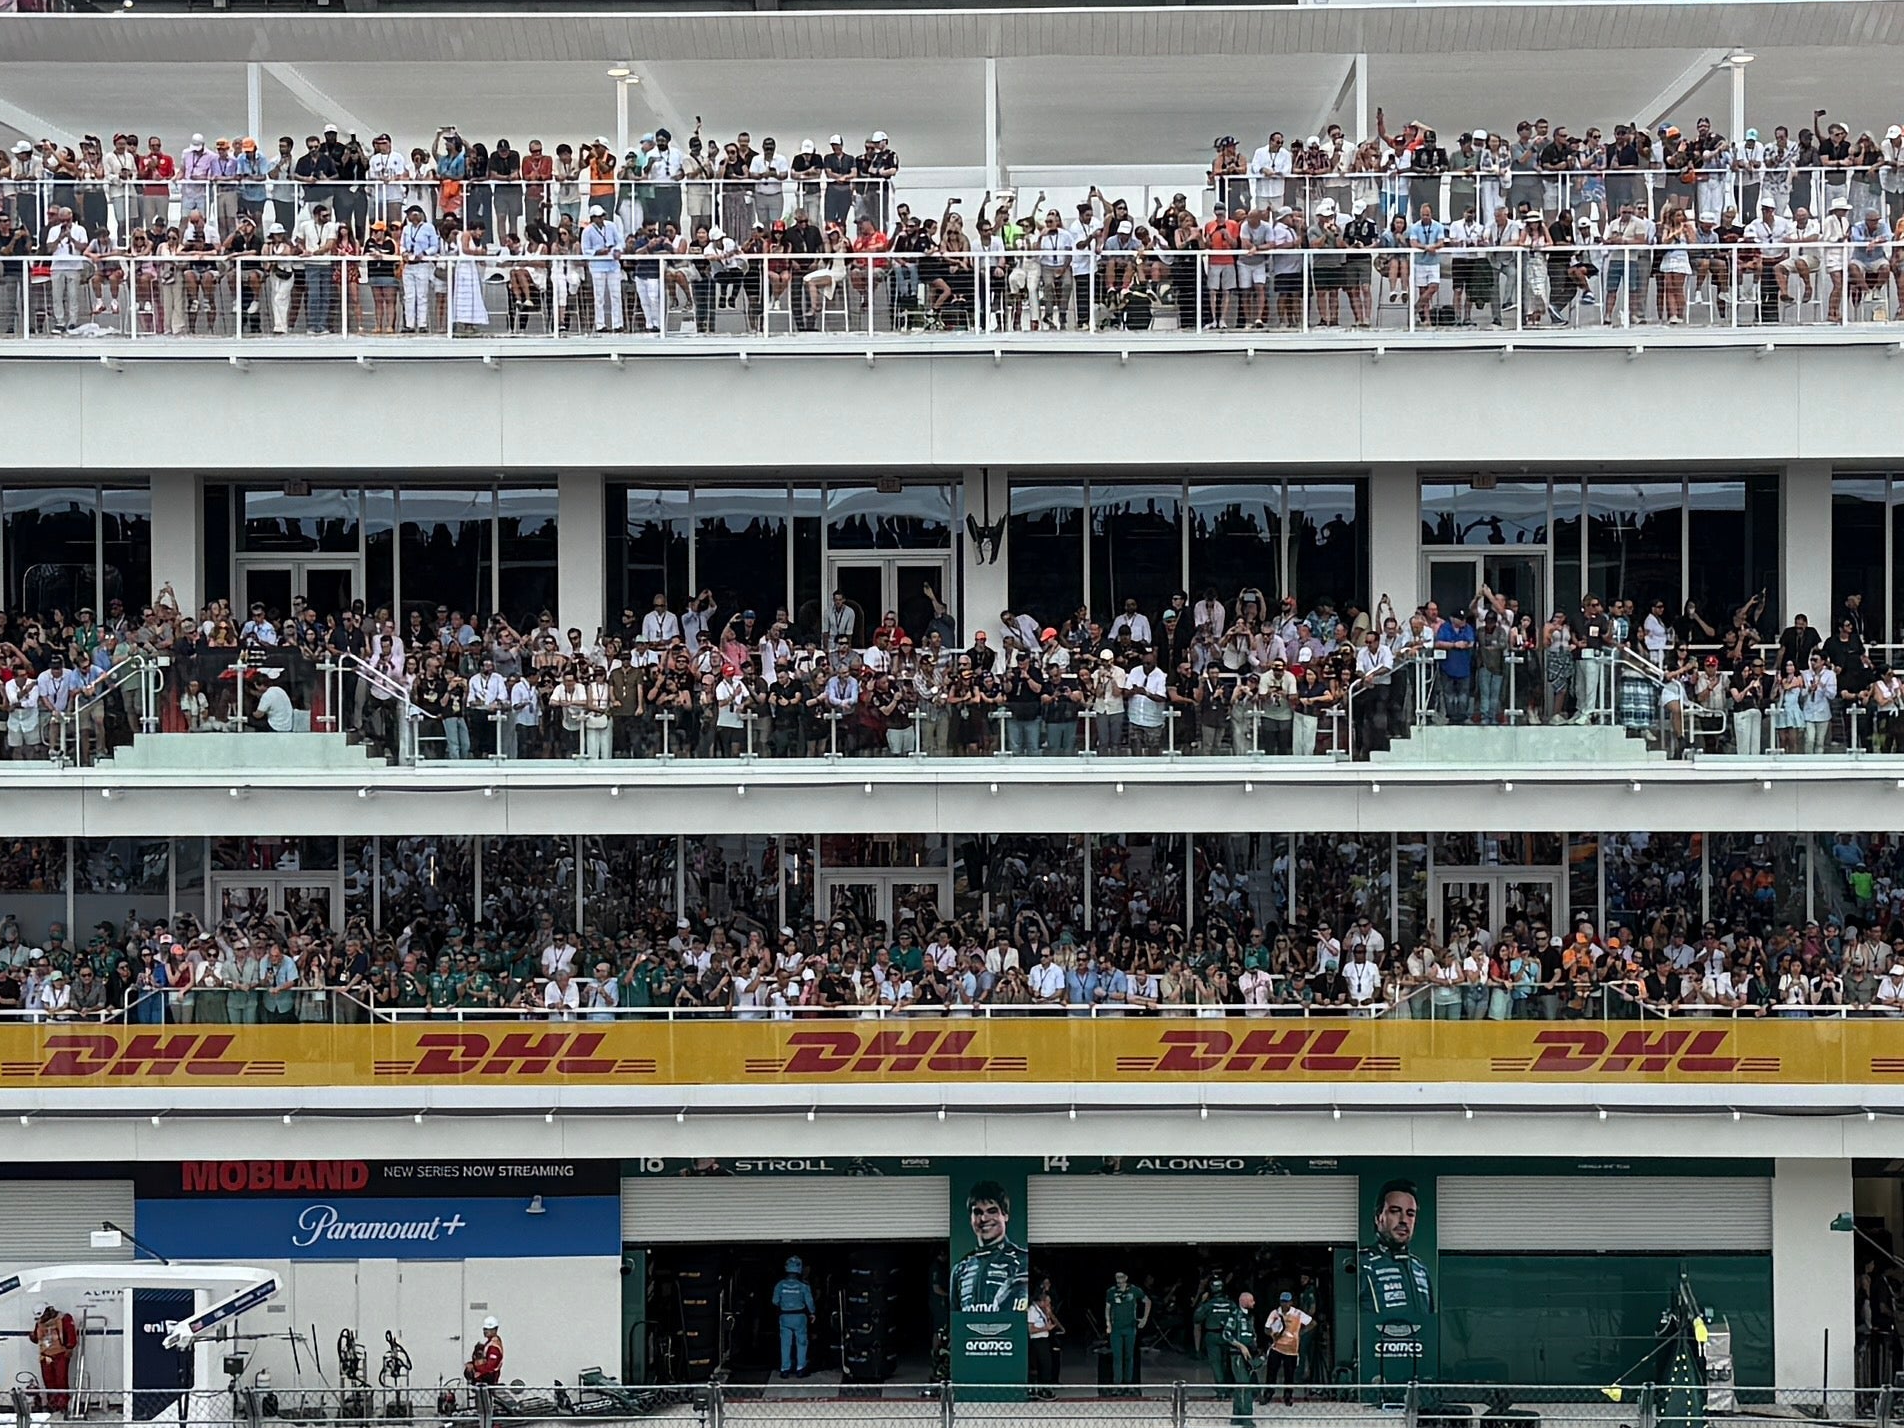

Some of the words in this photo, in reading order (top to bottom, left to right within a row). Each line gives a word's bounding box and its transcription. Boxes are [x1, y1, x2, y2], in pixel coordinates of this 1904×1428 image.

[42, 1035, 242, 1076] DHL
[415, 1033, 615, 1074] DHL
[786, 1031, 986, 1072] DHL
[1158, 1030, 1359, 1071] DHL
[1534, 1031, 1736, 1071] DHL
[181, 1161, 369, 1193] MOBLAND
[384, 1165, 414, 1178] NEW
[417, 1166, 460, 1179] SERIES
[462, 1165, 495, 1178] NOW
[498, 1165, 574, 1178] STREAMING
[735, 1159, 835, 1172] STROLL
[1043, 1155, 1070, 1173] 14
[1135, 1158, 1245, 1171] ALONSO
[292, 1205, 466, 1247] Paramount+
[965, 1341, 1013, 1351] aramco
